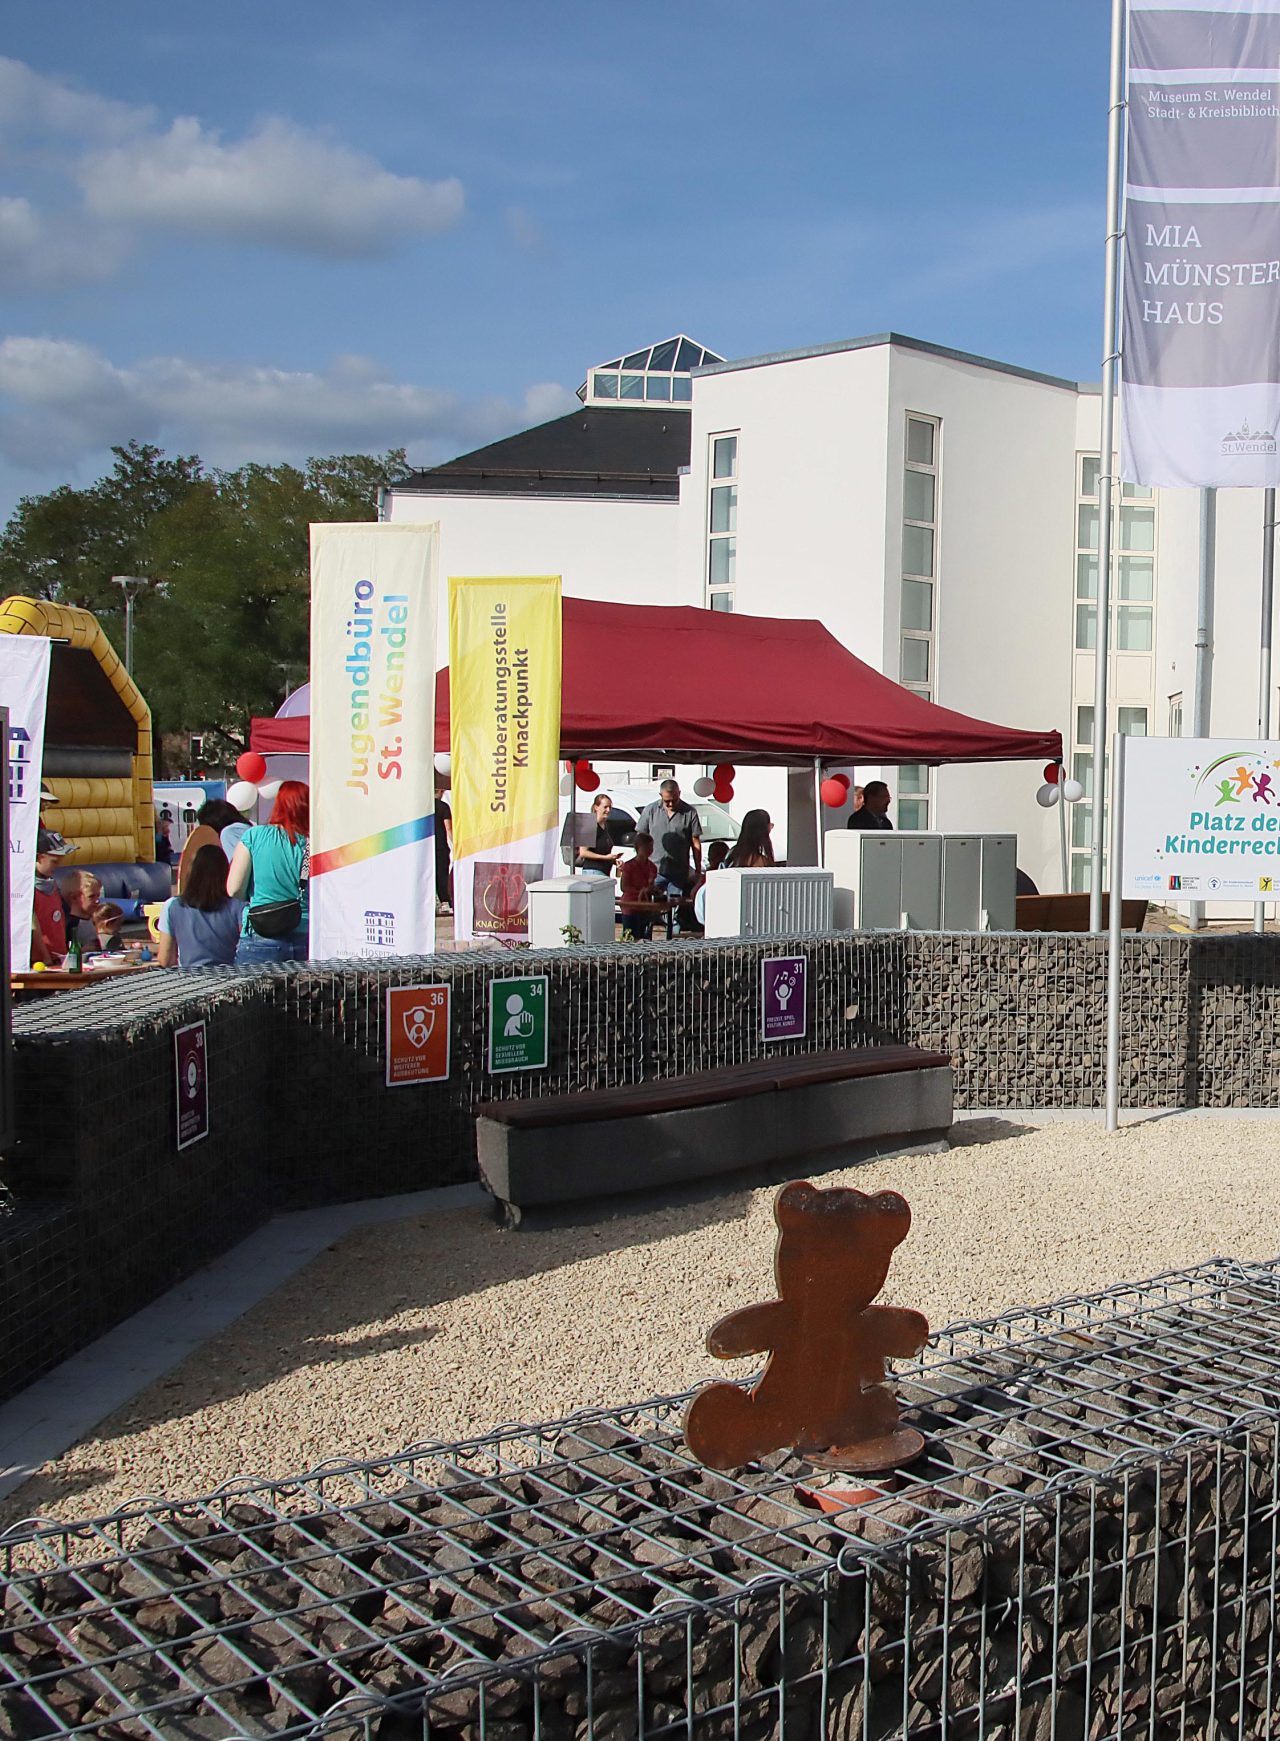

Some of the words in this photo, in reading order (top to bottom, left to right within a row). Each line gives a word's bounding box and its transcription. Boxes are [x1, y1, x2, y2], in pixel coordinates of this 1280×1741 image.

[1148, 90, 1201, 103] Museum
[1204, 90, 1220, 102] St.
[1223, 88, 1272, 101] Wendel
[1147, 106, 1185, 119] Stadt-
[1187, 107, 1196, 118] &
[1144, 223, 1203, 248] MIA
[1143, 258, 1280, 287] MÜNSTER
[1141, 299, 1224, 325] HAUS
[379, 595, 409, 727] Wendel
[345, 579, 375, 796] Jugendbüro
[490, 602, 512, 813] Suchtberatungsstelle
[512, 648, 533, 768] Knackpunkt
[377, 735, 403, 781] St.
[1189, 811, 1246, 832] Platz
[475, 920, 505, 929] KNACK
[793, 962, 803, 975] 31
[430, 993, 444, 1006] 36
[530, 984, 542, 996] 34
